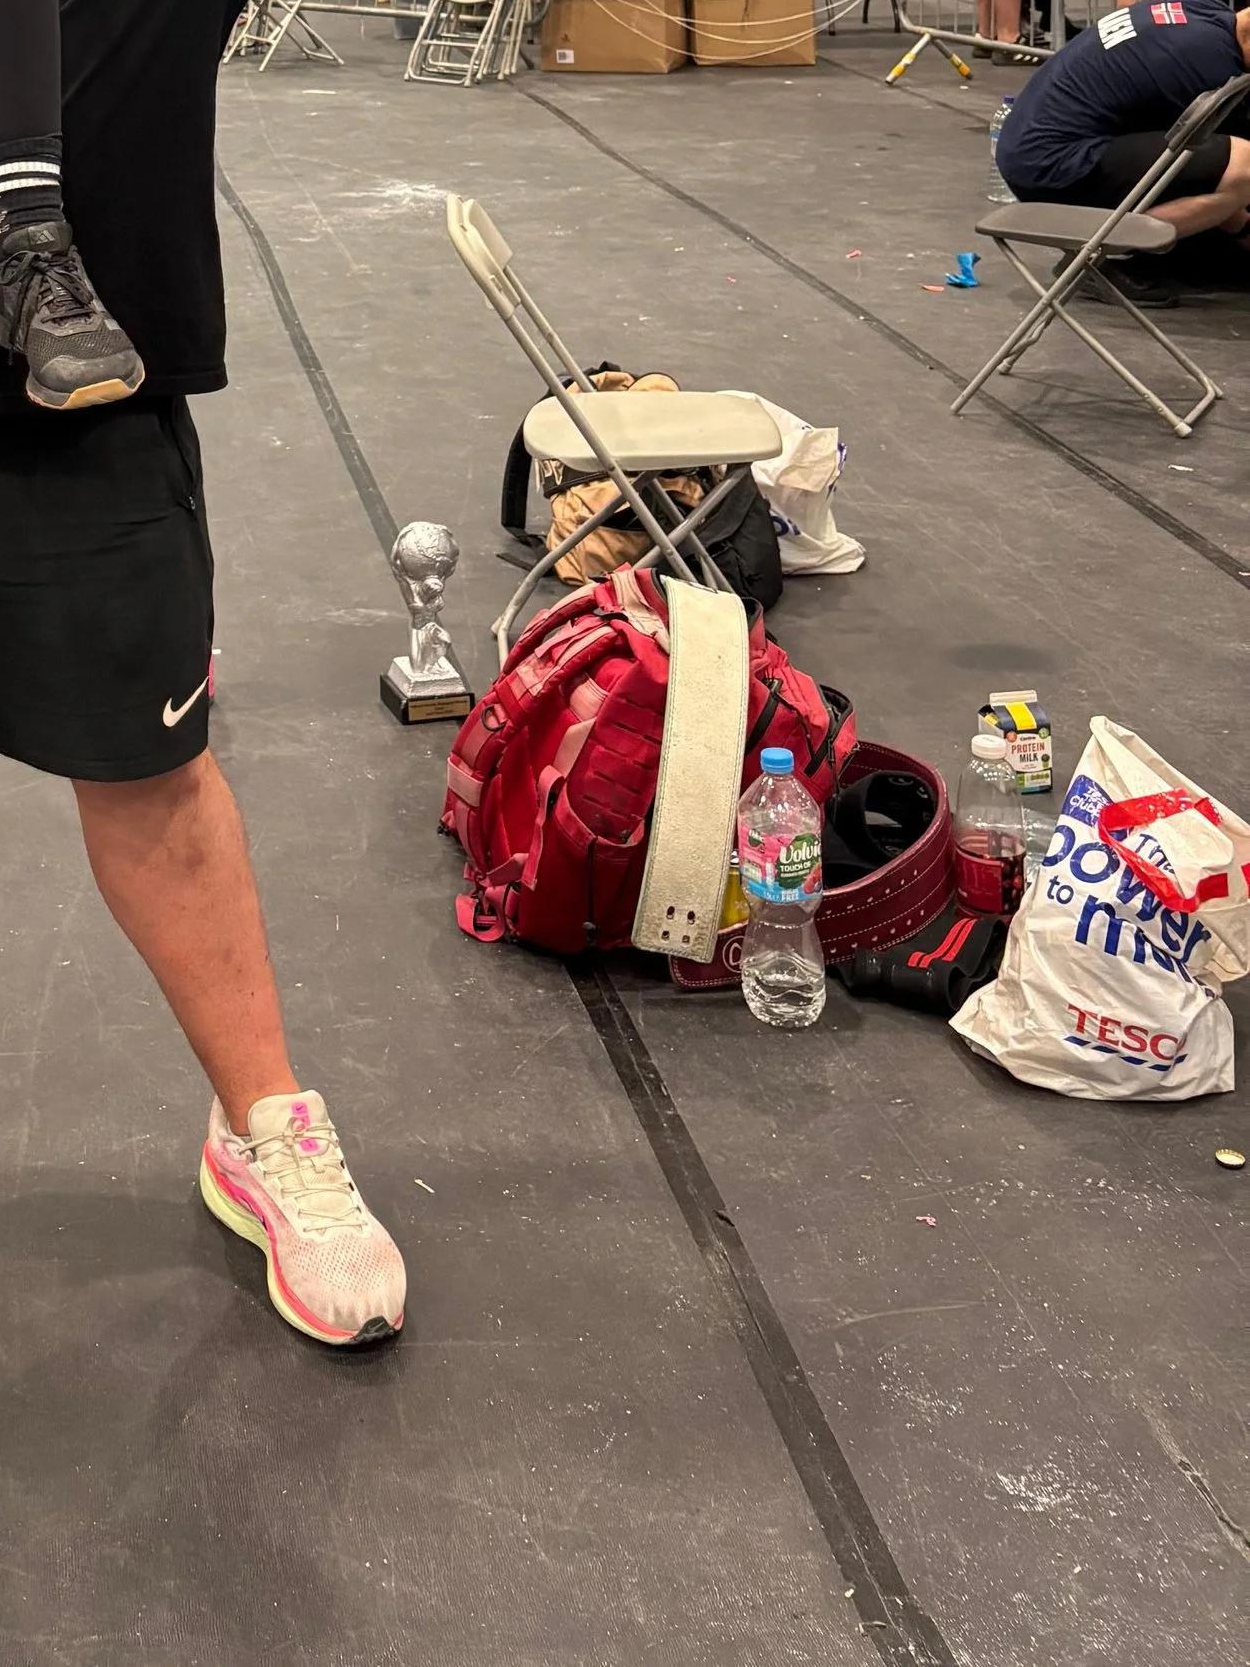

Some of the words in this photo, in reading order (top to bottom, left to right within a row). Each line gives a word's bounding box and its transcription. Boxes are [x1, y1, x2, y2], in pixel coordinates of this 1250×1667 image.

[1011, 742, 1045, 755] PROTEIN
[1019, 753, 1039, 763] MILK
[779, 863, 804, 873] TOUCH
[1046, 874, 1075, 905] to
